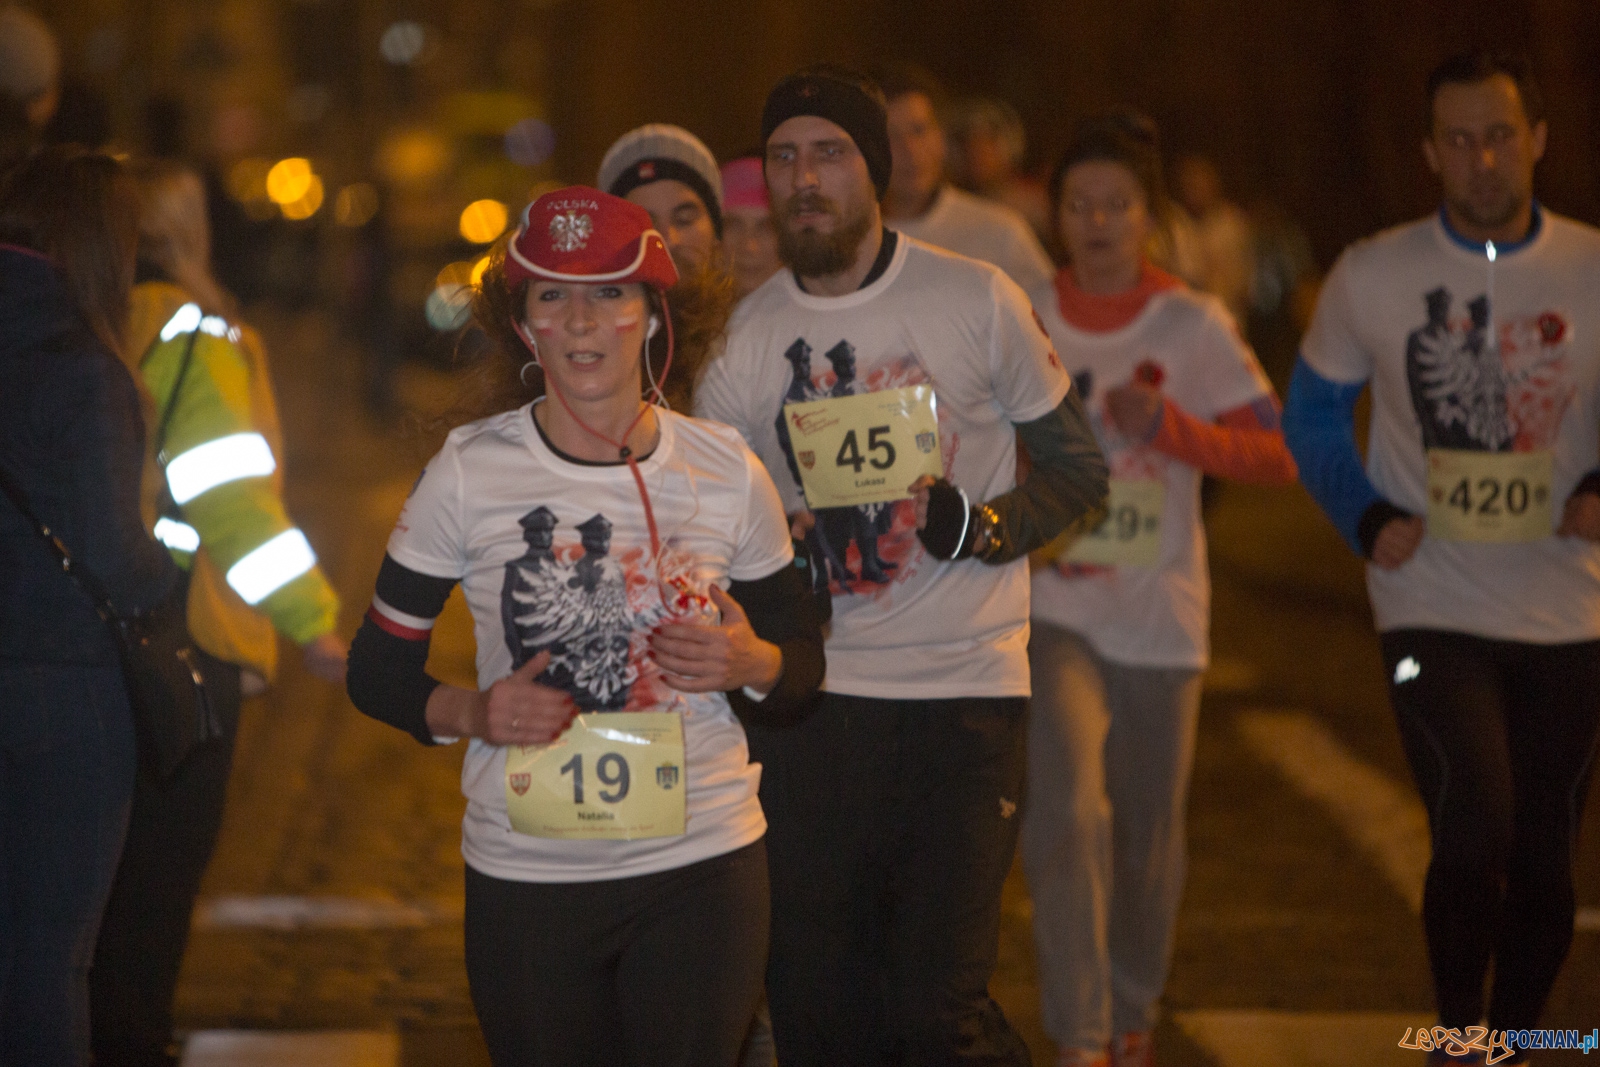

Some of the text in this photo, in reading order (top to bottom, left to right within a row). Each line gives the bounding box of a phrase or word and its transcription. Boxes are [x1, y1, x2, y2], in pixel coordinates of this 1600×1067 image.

[546, 199, 600, 211] POLSKA
[836, 425, 896, 473] 45
[1449, 477, 1529, 516] 420
[560, 752, 631, 804] 19
[577, 811, 615, 821] Natalia
